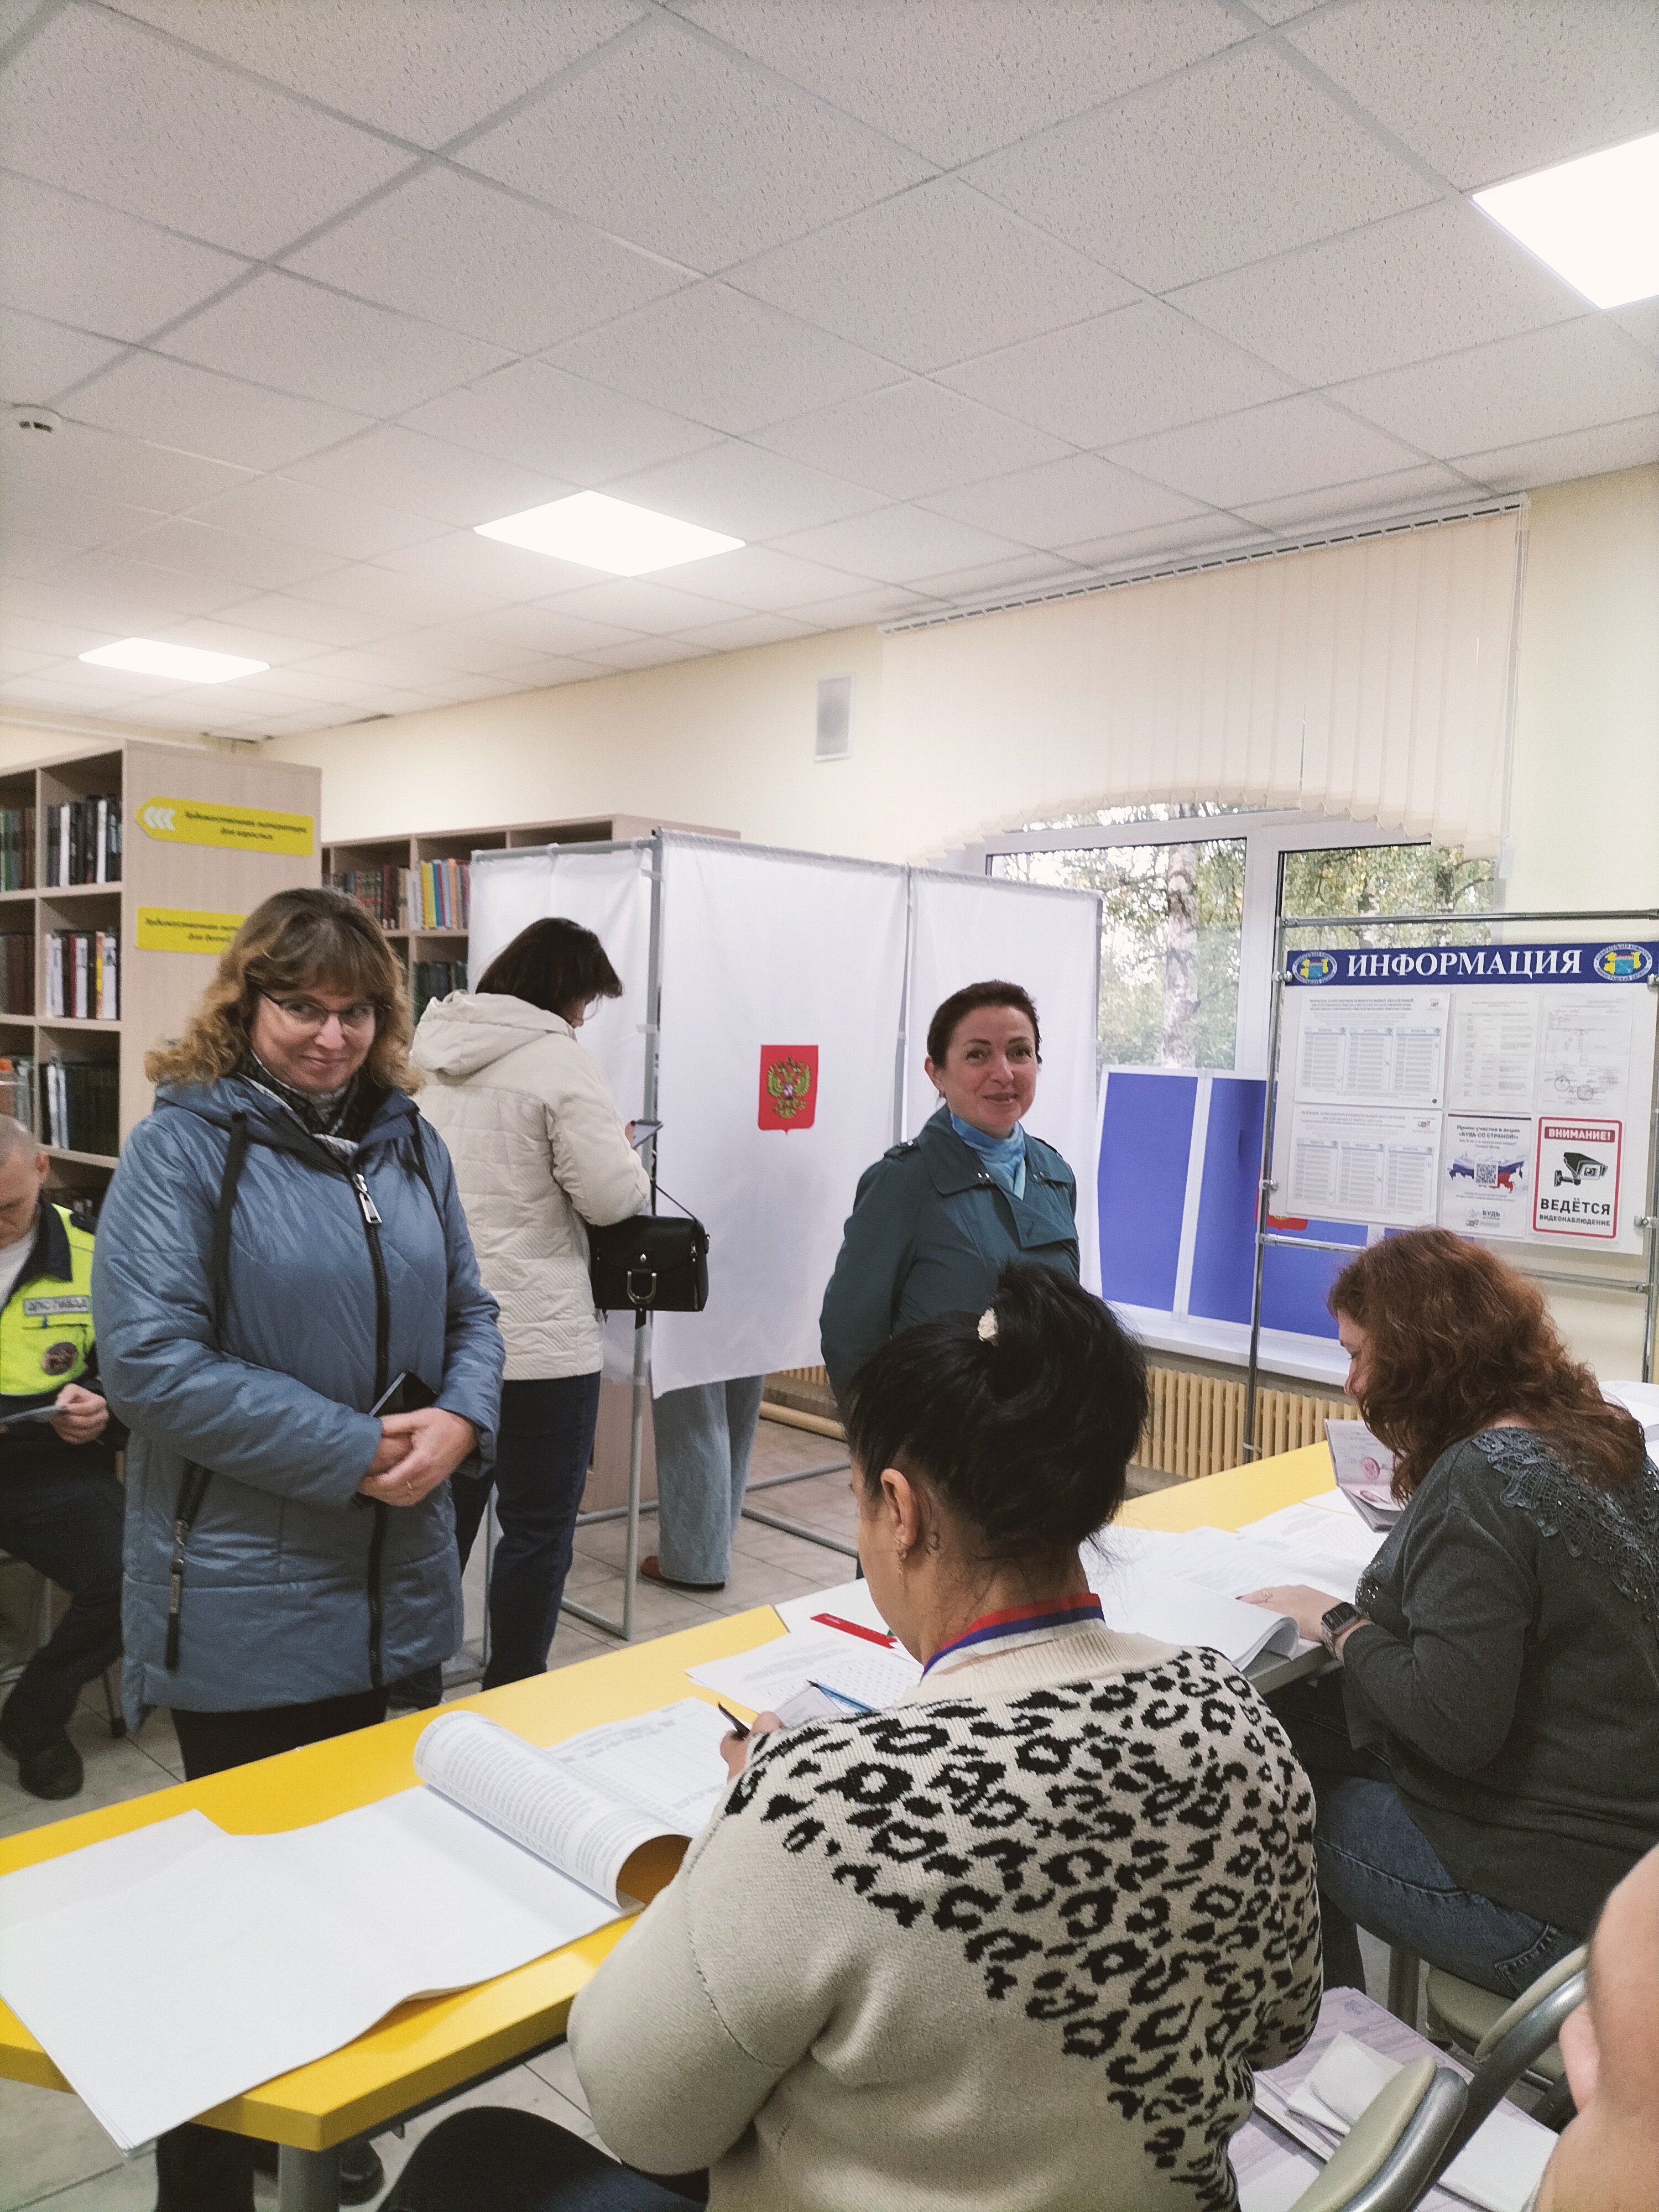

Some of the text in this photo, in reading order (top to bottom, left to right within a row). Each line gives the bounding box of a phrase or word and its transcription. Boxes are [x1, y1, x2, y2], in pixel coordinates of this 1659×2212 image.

[1347, 950, 1583, 979] ИНФОРМАЦИЯ
[1549, 1128, 1611, 1141] ВНИМАНИЕ!
[1541, 1197, 1610, 1215] ВЕДЁТСЯ
[1539, 1214, 1610, 1227] ВИДЕОНАБЛЮДЕНИЕ
